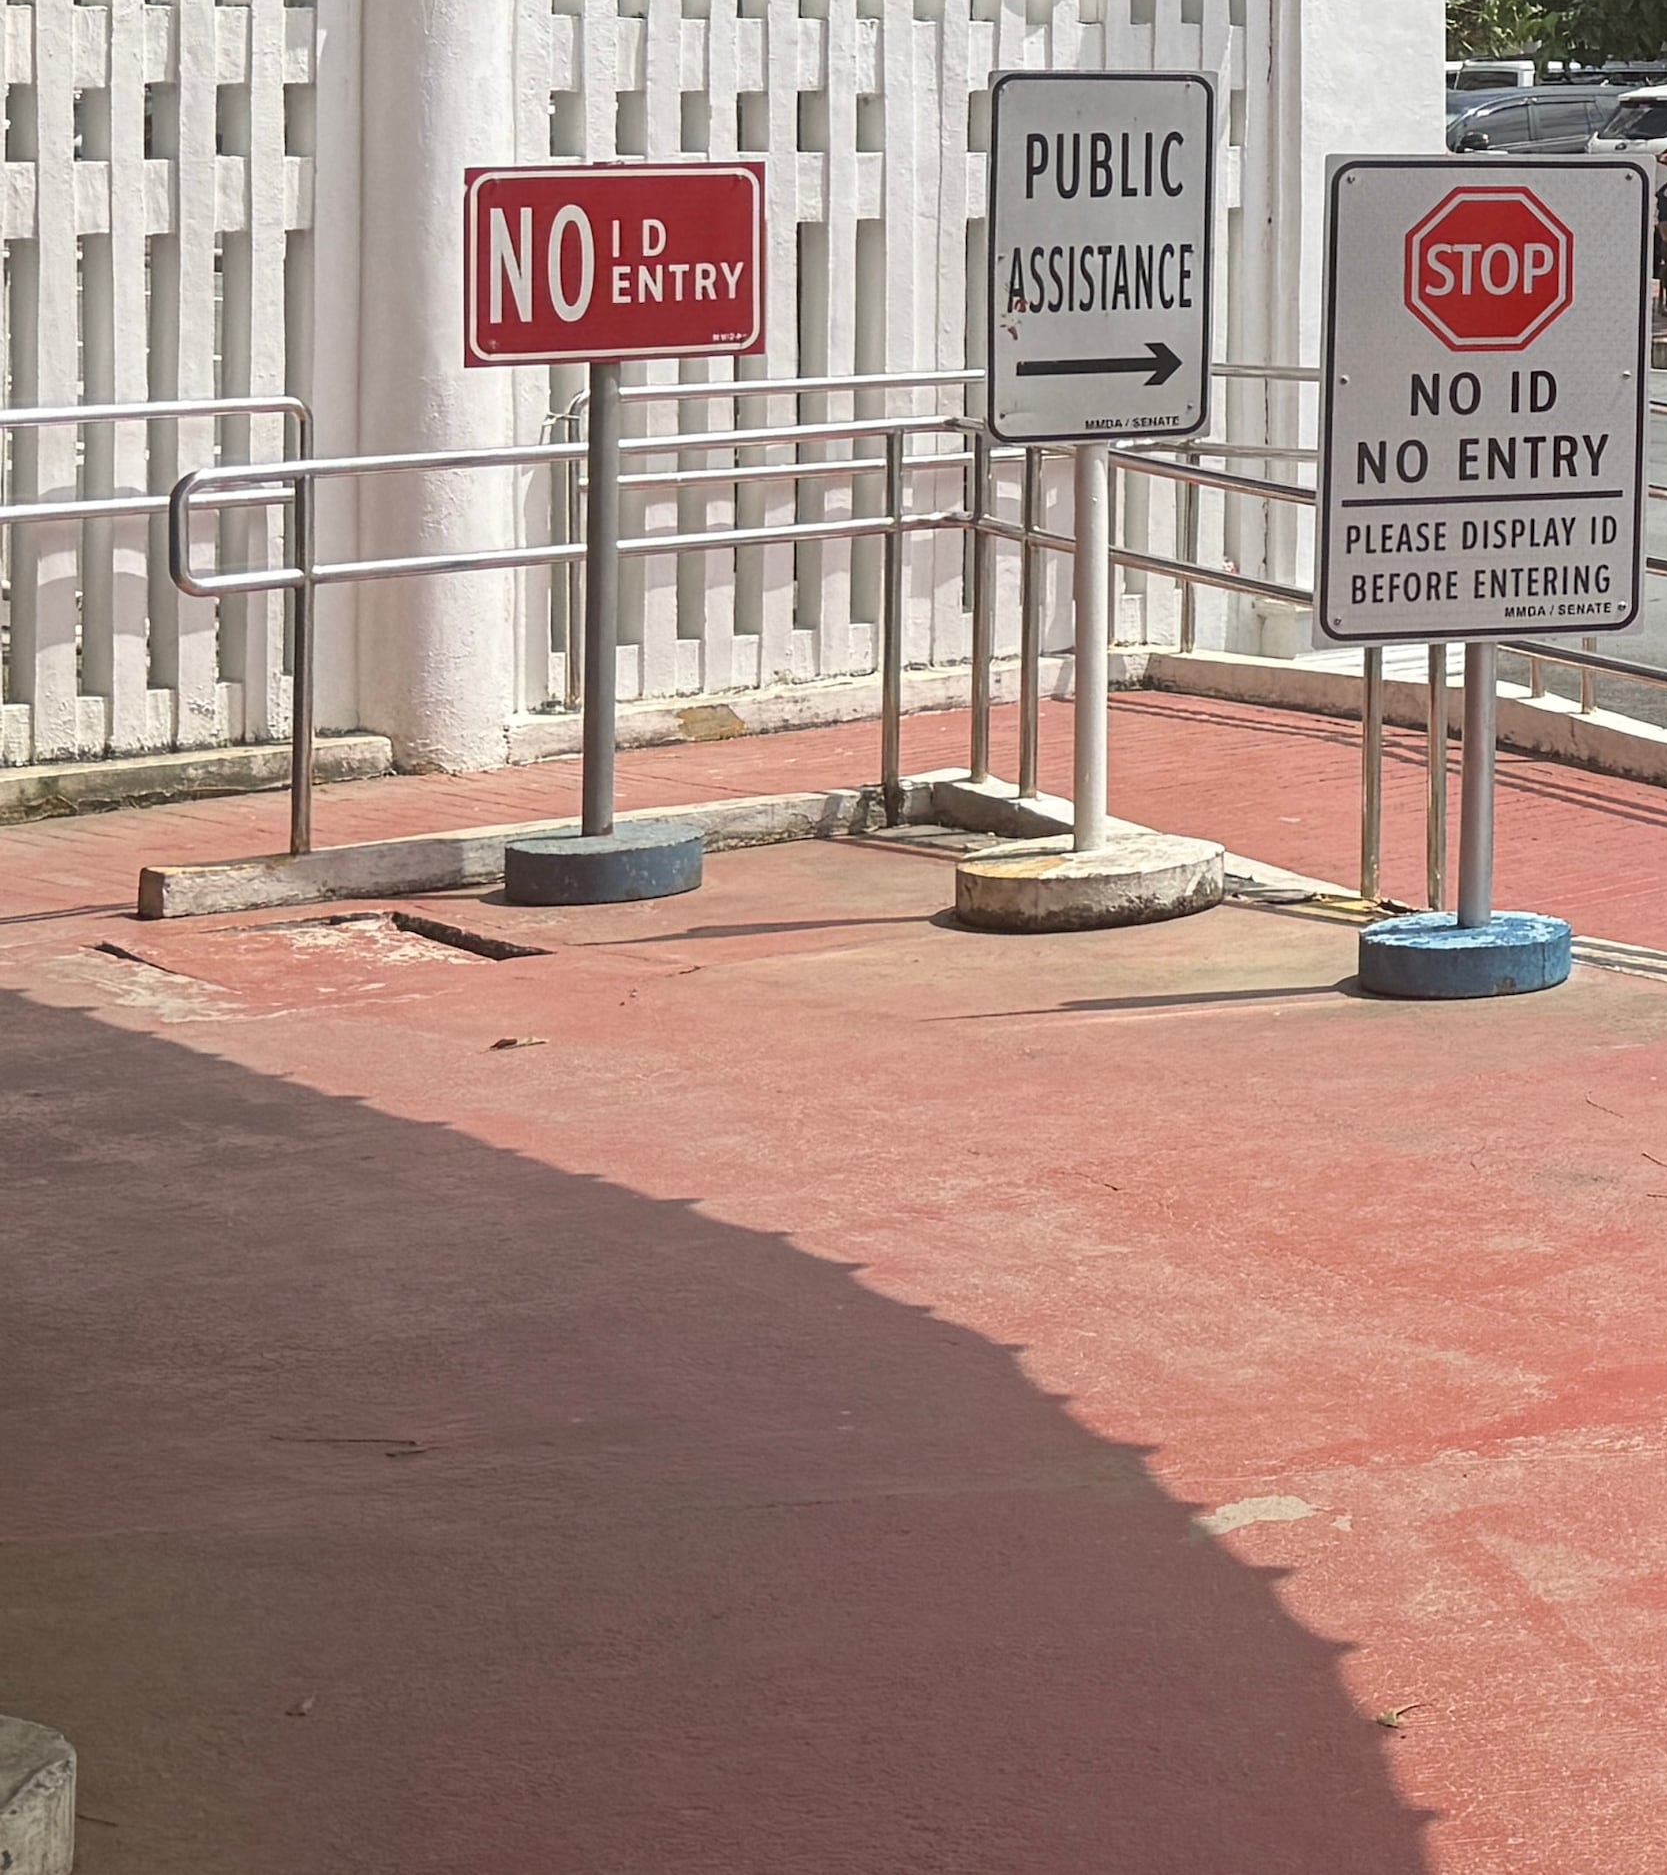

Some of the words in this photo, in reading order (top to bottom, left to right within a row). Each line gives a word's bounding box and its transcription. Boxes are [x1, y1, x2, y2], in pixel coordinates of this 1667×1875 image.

[1025, 130, 1185, 200] PUBLIC
[489, 203, 596, 324] NO
[612, 261, 745, 304] ENTRY
[1006, 243, 1194, 314] ASSISTANCE
[1425, 242, 1555, 296] STOP
[1410, 371, 1482, 417] NO
[1510, 370, 1558, 414] ID
[1132, 415, 1180, 428] SENATE
[1356, 438, 1429, 485] NO
[1458, 433, 1610, 482] ENTRY
[1345, 521, 1448, 555] PLEASE
[1461, 516, 1577, 550] DISPLAY
[1590, 515, 1618, 545] ID
[1351, 570, 1459, 605] BEFORE
[1473, 564, 1611, 600] ENTERING
[1504, 605, 1546, 618] MMDA
[1557, 602, 1612, 616] SENATE
